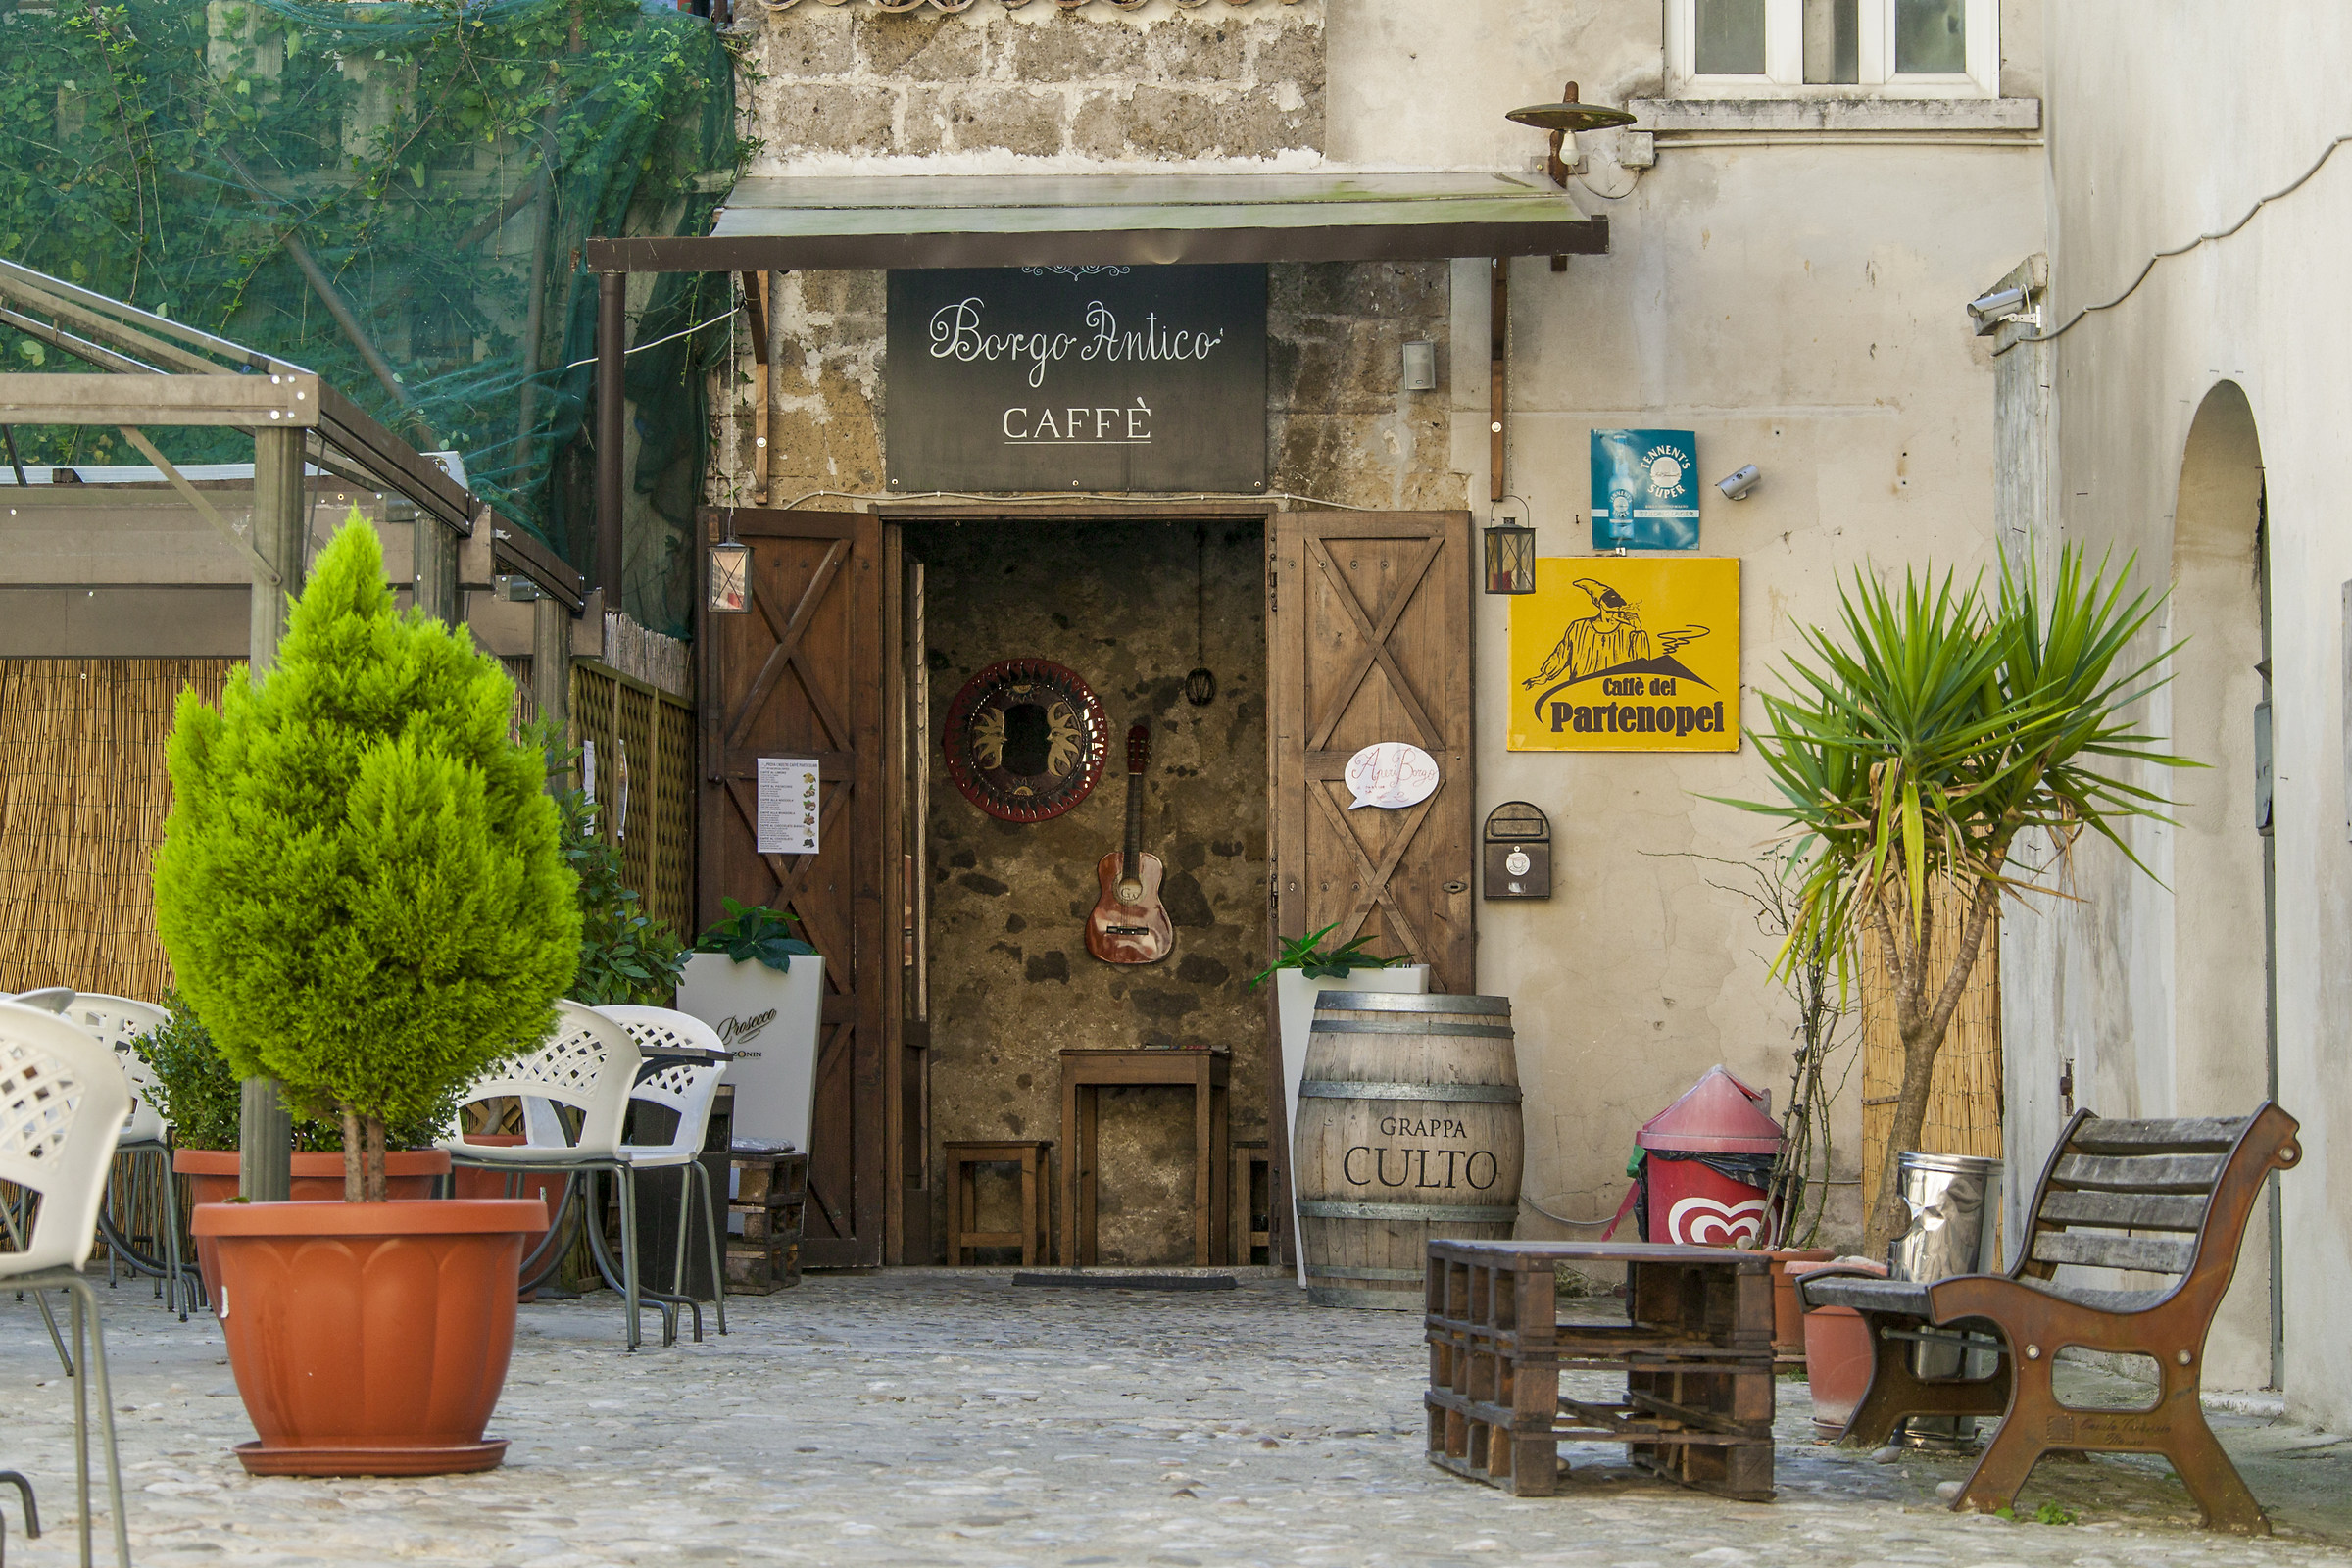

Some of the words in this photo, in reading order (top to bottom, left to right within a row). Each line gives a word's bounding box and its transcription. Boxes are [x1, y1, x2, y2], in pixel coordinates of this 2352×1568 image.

[929, 296, 1077, 388] Borgo
[1081, 300, 1222, 362] Antico
[1003, 396, 1152, 439] CAFFÈ
[1640, 444, 1691, 470] TENNENT'S
[1647, 483, 1686, 499] SUPER
[1602, 677, 1644, 696] Caffè
[1649, 677, 1677, 696] dei
[1550, 701, 1725, 737] Partenopei
[716, 1007, 777, 1045] Prosecco
[1380, 1117, 1467, 1139] GRAPPA
[1343, 1146, 1498, 1190] CULTO
